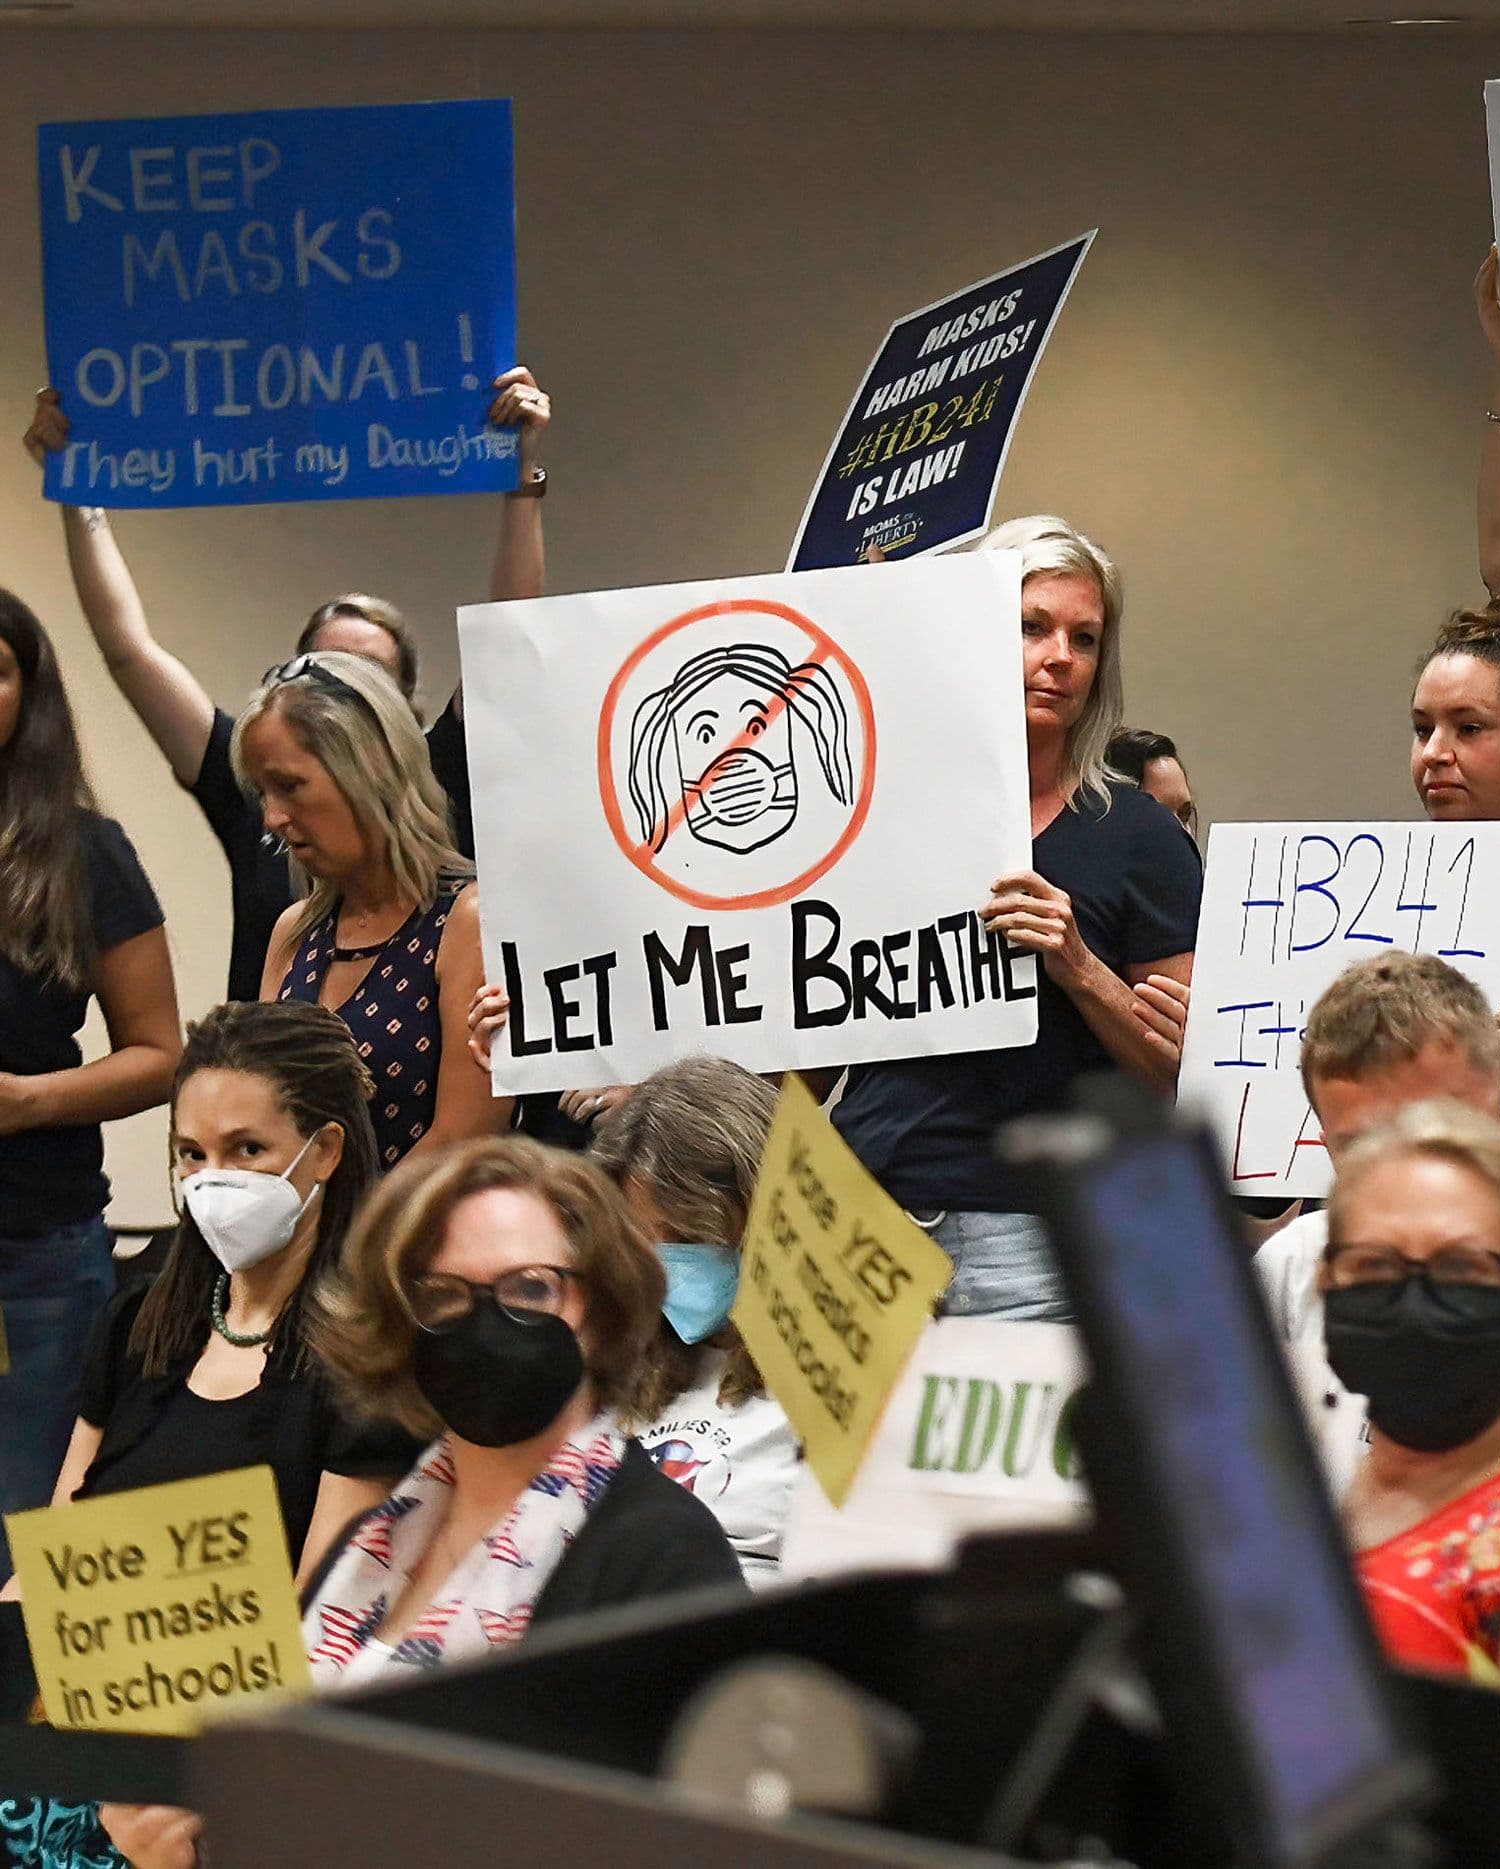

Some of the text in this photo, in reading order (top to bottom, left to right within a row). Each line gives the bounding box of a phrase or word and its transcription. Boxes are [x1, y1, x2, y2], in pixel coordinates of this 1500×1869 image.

[61, 140, 280, 222] KEEP
[123, 207, 402, 306] MASKS
[917, 288, 1023, 358] MASKS
[863, 319, 1036, 420] HARM KIDS!
[60, 441, 176, 493] They
[193, 436, 281, 487] hurt
[294, 441, 350, 486] my
[838, 374, 1004, 479] #HB241
[846, 440, 966, 521] IS LAW!
[1240, 831, 1486, 964] HB241
[500, 899, 1036, 1057] LET ME BREATHE
[1232, 1081, 1328, 1181] LA
[842, 1217, 914, 1305] YES
[42, 1511, 250, 1592] Vote YES
[55, 1582, 262, 1657] for masks
[59, 1640, 284, 1725] in schools!
